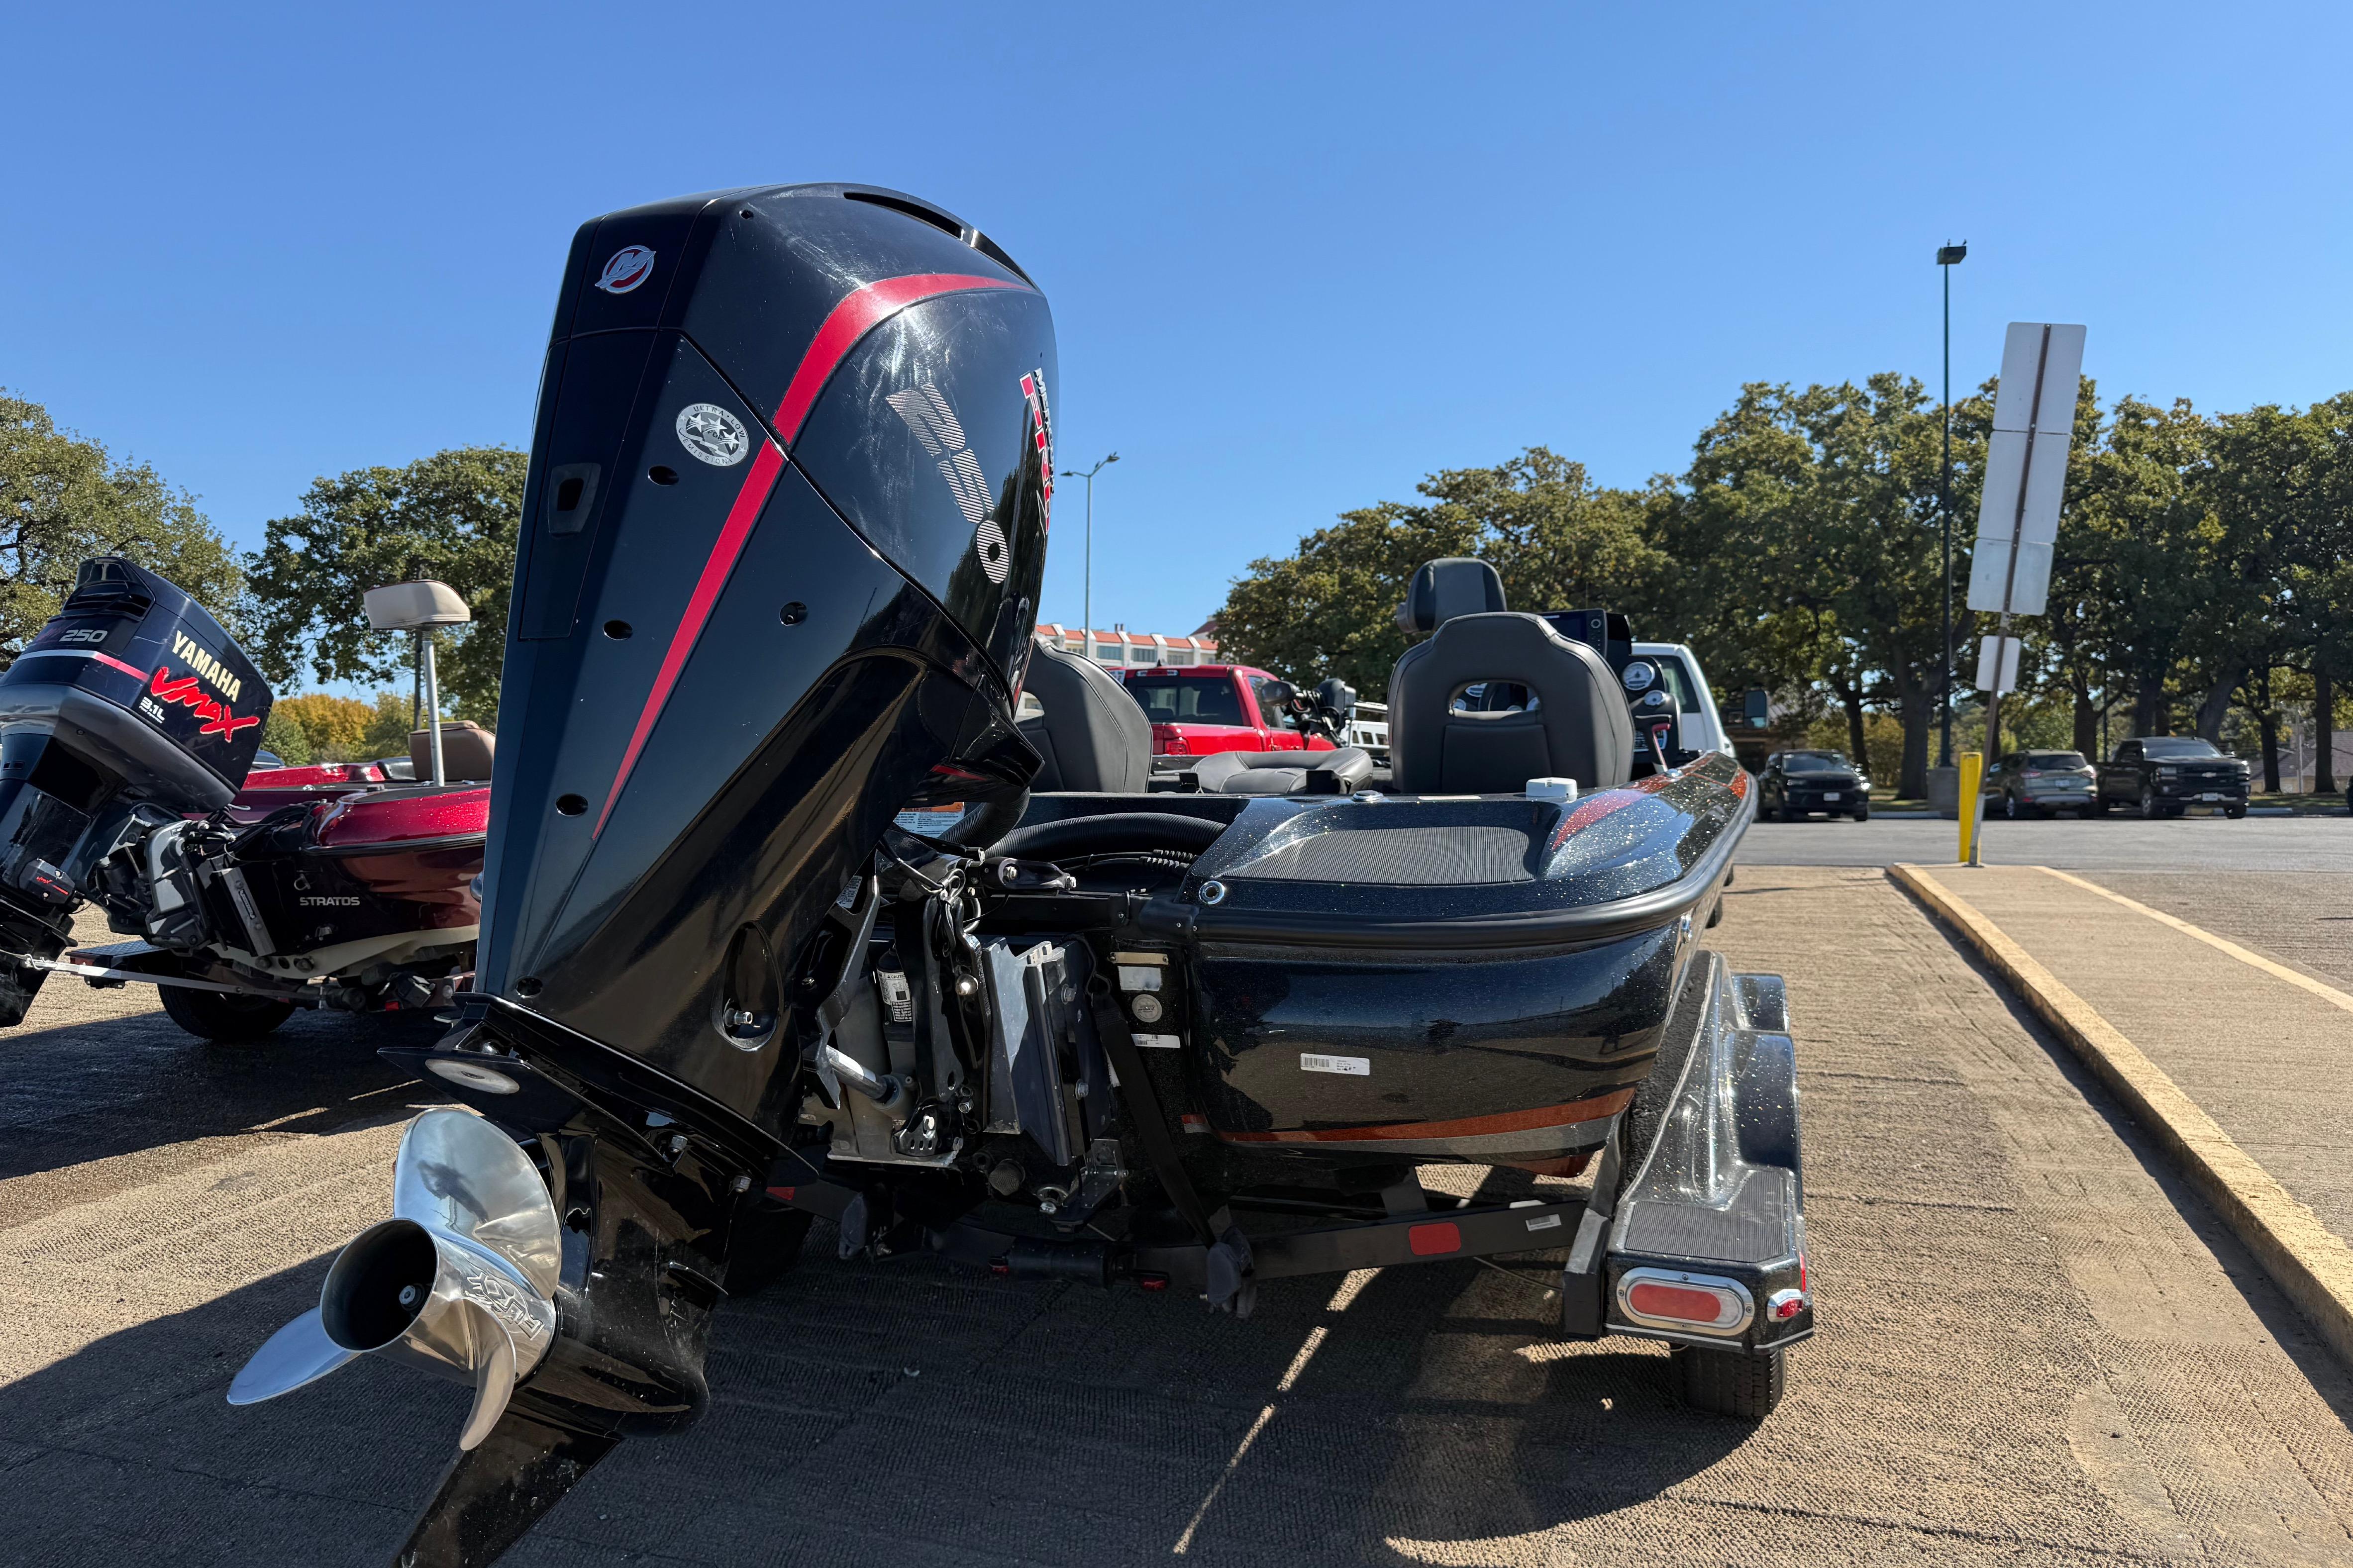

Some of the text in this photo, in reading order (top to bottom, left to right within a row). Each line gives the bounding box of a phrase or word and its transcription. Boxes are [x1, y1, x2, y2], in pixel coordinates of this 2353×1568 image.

[693, 405, 746, 438] ULTRA LOW
[683, 438, 728, 465] EMISSION
[885, 383, 1009, 584] 250
[58, 629, 108, 642] 250
[172, 630, 242, 702] YAMAHA
[140, 696, 165, 721] 3.1L
[300, 897, 361, 906] STRATOS
